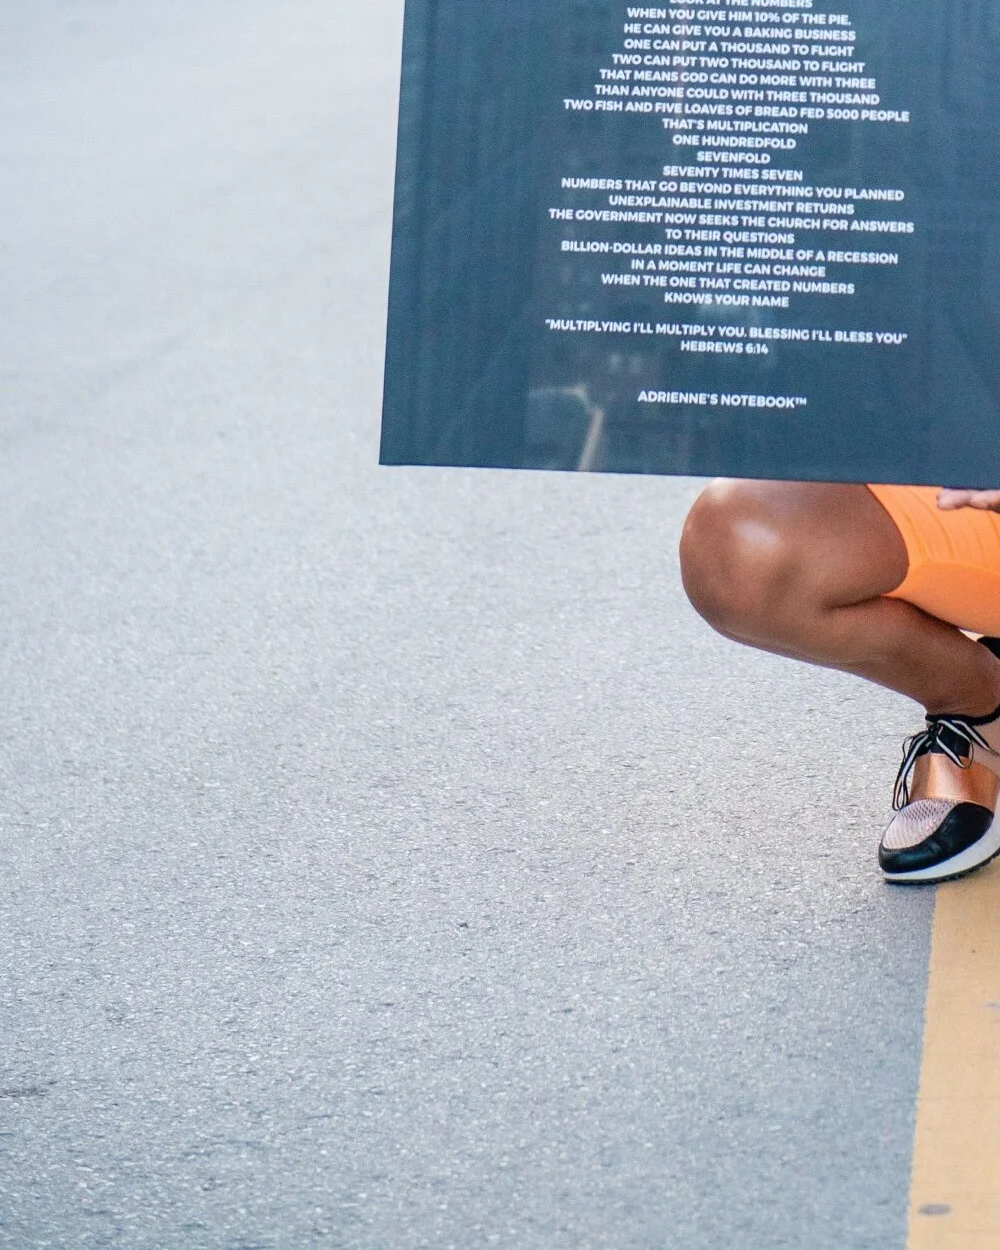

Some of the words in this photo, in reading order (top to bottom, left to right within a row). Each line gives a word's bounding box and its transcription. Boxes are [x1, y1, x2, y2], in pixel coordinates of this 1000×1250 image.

[611, 53, 642, 65] TWO
[642, 54, 670, 66] CAN
[672, 55, 697, 67] PUT
[699, 56, 729, 68] TWO
[730, 57, 801, 70] THOUSAND
[802, 59, 820, 71] TO
[821, 60, 865, 72] FLIGHT
[599, 69, 632, 80] THAT
[633, 70, 679, 82] MEANS
[679, 71, 709, 83] GOD
[709, 72, 737, 84] CAN
[738, 73, 758, 85] DO
[759, 74, 797, 86] MORE
[798, 75, 832, 87] WITH
[834, 76, 876, 88] THREE
[594, 84, 629, 97] THAN
[630, 85, 684, 98] ANYONE
[685, 87, 729, 100] COULD
[730, 89, 764, 101] WITH
[765, 90, 807, 102] THREE
[809, 91, 880, 105] THOUSAND
[562, 99, 593, 111] TWO
[594, 100, 623, 112] FISH
[624, 101, 653, 113] AND
[654, 102, 682, 114] FIVE
[684, 103, 733, 115] LOAVES
[734, 104, 752, 116] OF
[754, 105, 798, 117] BREAD
[799, 106, 825, 118] FED
[826, 107, 859, 119] 5000
[860, 108, 910, 121] PEOPLE
[661, 118, 705, 130] THAT'S
[706, 119, 808, 133] MULTIPLICATION
[672, 134, 700, 146] ONE
[701, 135, 797, 149] HUNDREDFOLD
[696, 150, 771, 164] SEVENFOLD
[662, 165, 720, 178] SEVENTY
[721, 167, 759, 179] TIMES
[761, 168, 803, 181] SEVEN
[561, 177, 623, 191] NUMBERS
[624, 179, 657, 192] THAT
[658, 180, 678, 193] GO
[679, 181, 732, 194] BEYOND
[733, 183, 813, 197] EVERYTHING
[815, 186, 842, 198] YOU
[843, 187, 905, 200] PLANNED
[608, 195, 712, 209] UNEXPLAINABLE
[713, 198, 794, 212] INVESTMENT
[795, 201, 855, 214] RETURNS
[548, 208, 573, 221] THE
[574, 209, 663, 224] GOVERNMENT
[664, 212, 697, 225] NOW
[698, 213, 739, 226] SEEKS
[740, 215, 765, 227] THE
[766, 216, 821, 229] CHURCH
[822, 218, 848, 230] FOR
[850, 219, 914, 232] ANSWERS
[664, 228, 682, 240] TO
[683, 229, 721, 241] THEIR
[722, 230, 795, 245] QUESTIONS
[560, 240, 662, 255] BILLION-DOLLAR
[664, 244, 702, 257] IDEAS
[703, 245, 718, 257] IN
[719, 246, 744, 258] THE
[746, 247, 794, 260] MIDDLE
[795, 249, 814, 261] OF
[815, 249, 826, 261] A
[827, 250, 898, 264] RECESSION
[600, 273, 640, 286] WHEN
[642, 275, 668, 287] THE
[669, 276, 696, 288] ONE
[698, 277, 731, 289] THAT
[732, 278, 791, 292] CREATED
[792, 280, 855, 294] NUMBERS
[663, 292, 713, 304] KNOWS
[714, 294, 750, 306] YOUR
[751, 295, 789, 307] NAME
[632, 322, 654, 334] I'LL
[655, 323, 716, 337] MULTIPLY
[748, 326, 810, 340] BLESSING
[811, 329, 832, 341] I'LL
[834, 329, 874, 342] BLESS
[680, 340, 743, 353] HEBREWS
[744, 342, 769, 354] 6:14
[637, 390, 719, 406] ADRIENNE'S
